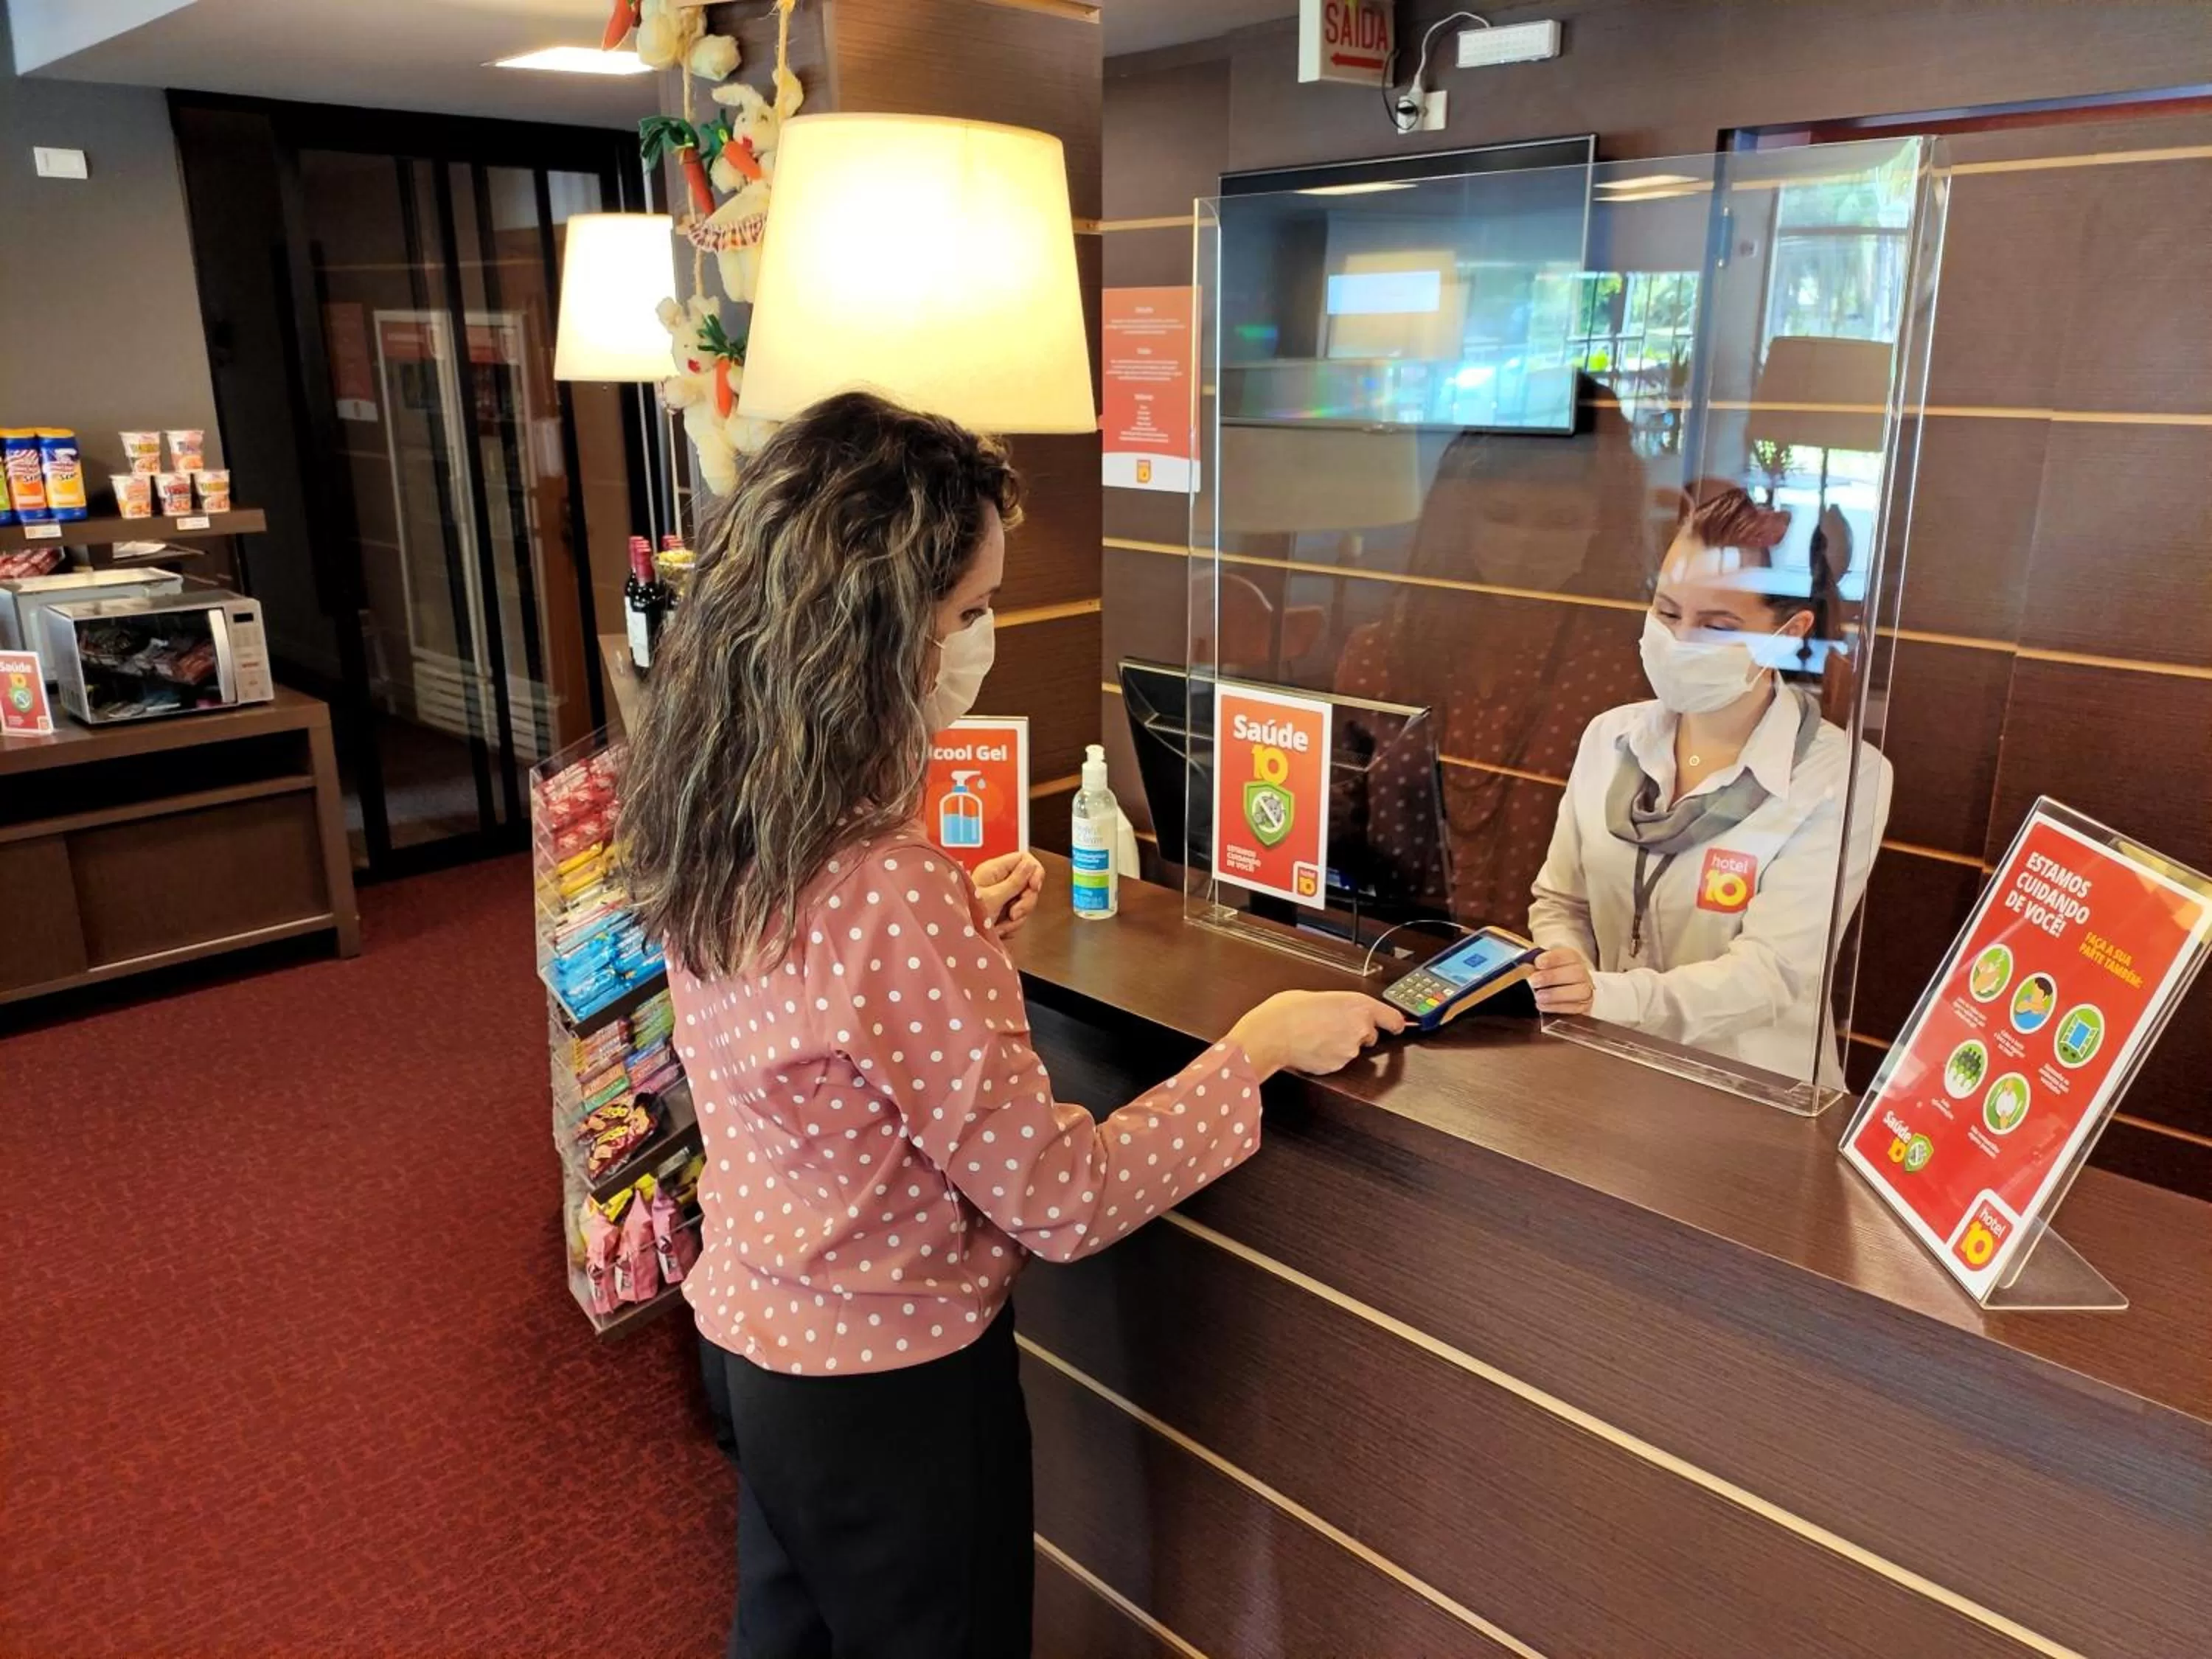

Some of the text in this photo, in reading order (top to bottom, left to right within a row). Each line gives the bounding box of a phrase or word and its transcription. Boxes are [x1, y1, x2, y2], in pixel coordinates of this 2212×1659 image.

[1234, 714, 1310, 752] Saúde
[976, 744, 1008, 762] Gel
[1251, 743, 1289, 785] 10
[1710, 852, 1748, 874] hotel
[2026, 851, 2093, 898] ESTAMOS
[1704, 869, 1747, 907] 10
[2016, 872, 2090, 925] CUIDANDO
[2004, 890, 2067, 939] DE VOCÊ!
[1882, 1110, 1912, 1144] Saúde
[1887, 1137, 1907, 1164] 10
[1979, 1206, 2006, 1239] hotel
[1960, 1220, 1994, 1266] 10
